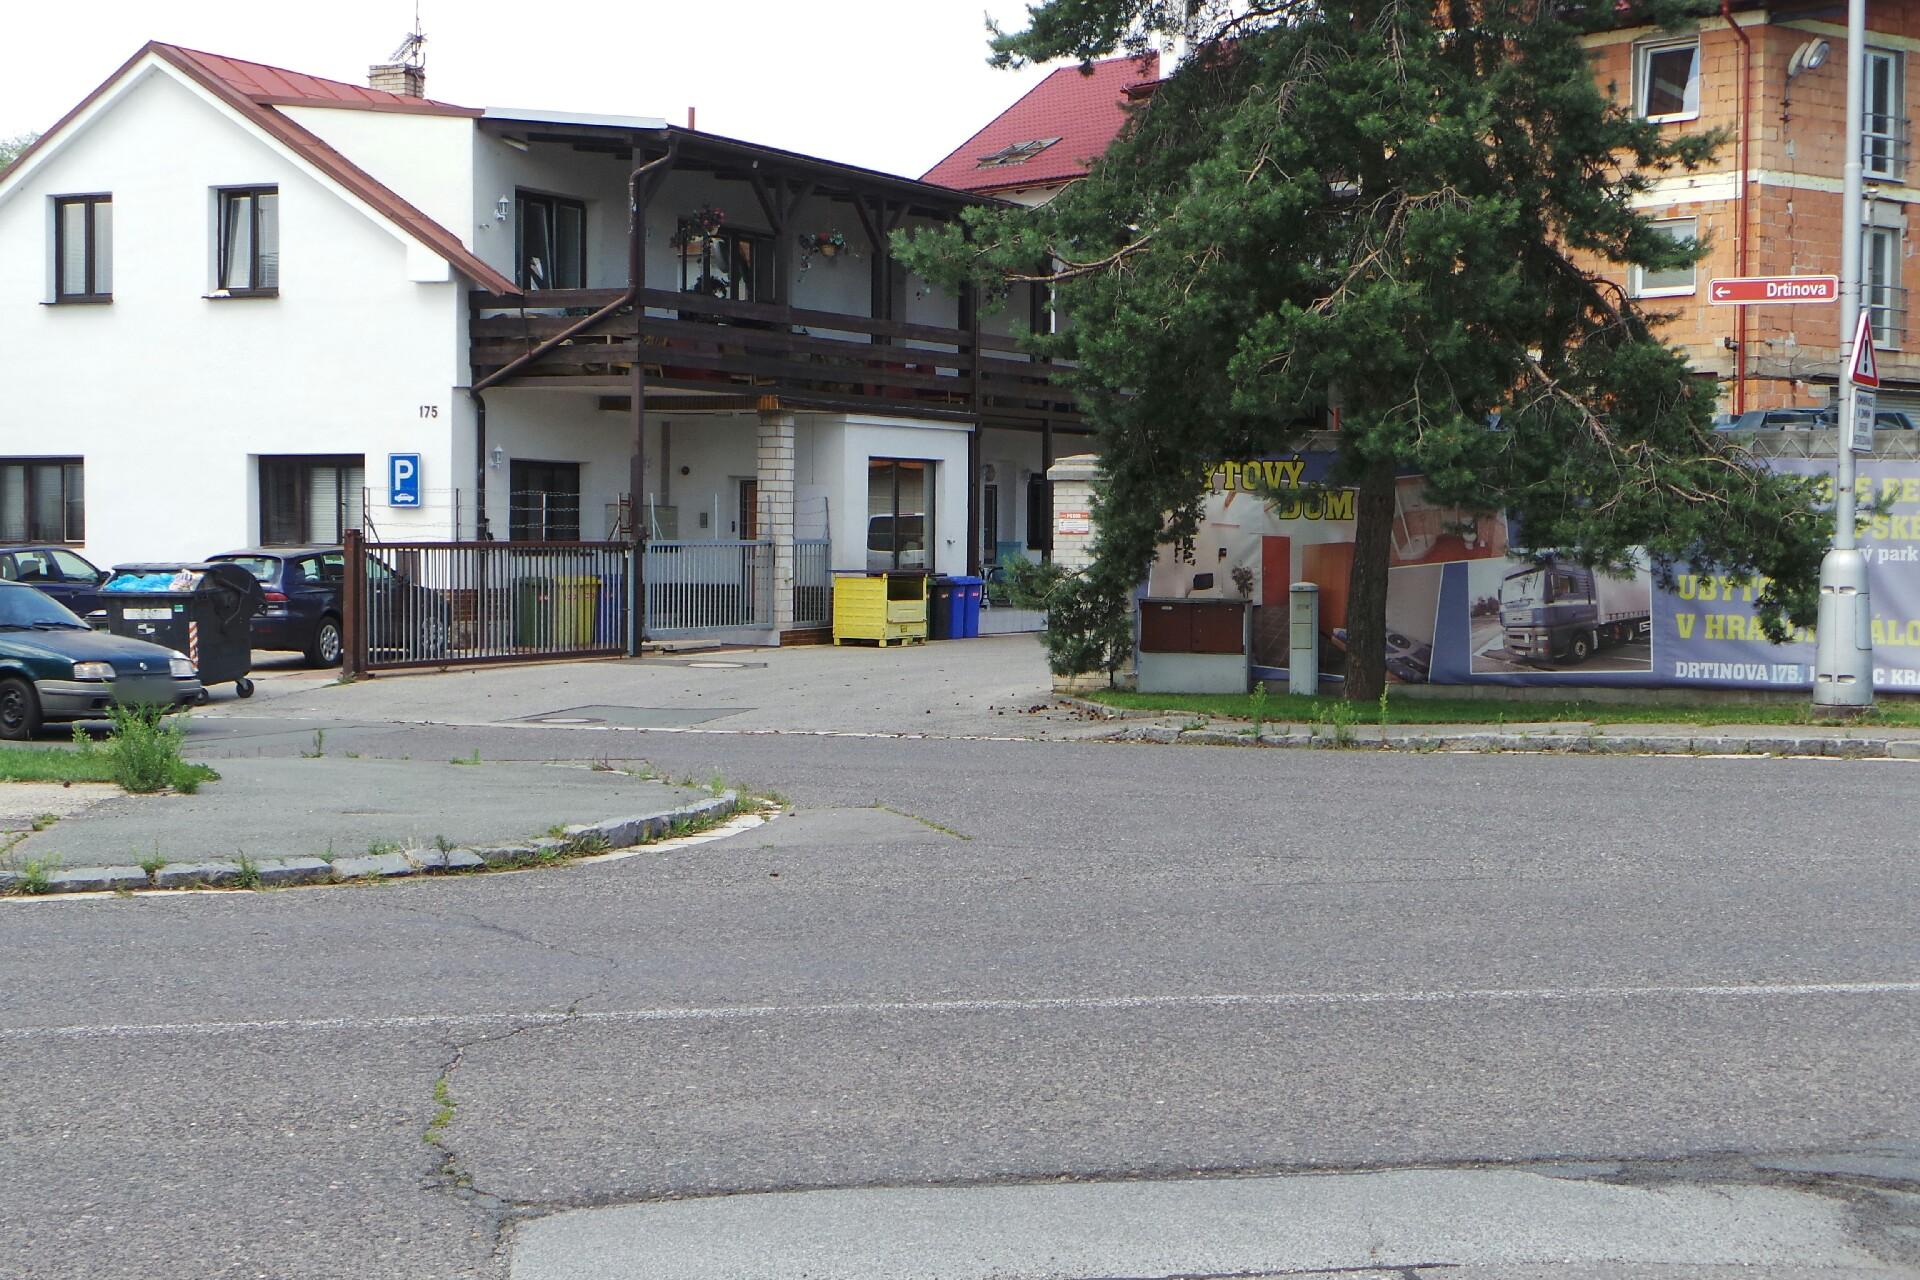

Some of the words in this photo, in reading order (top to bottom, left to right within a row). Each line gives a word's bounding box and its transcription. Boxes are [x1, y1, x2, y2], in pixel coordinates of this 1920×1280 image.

[1766, 282, 1827, 297] Drtinova
[419, 405, 438, 418] 175
[394, 459, 414, 491] P
[1879, 546, 1919, 564] park
[1676, 613, 1696, 639] V
[1675, 661, 1768, 681] DRTINOVA
